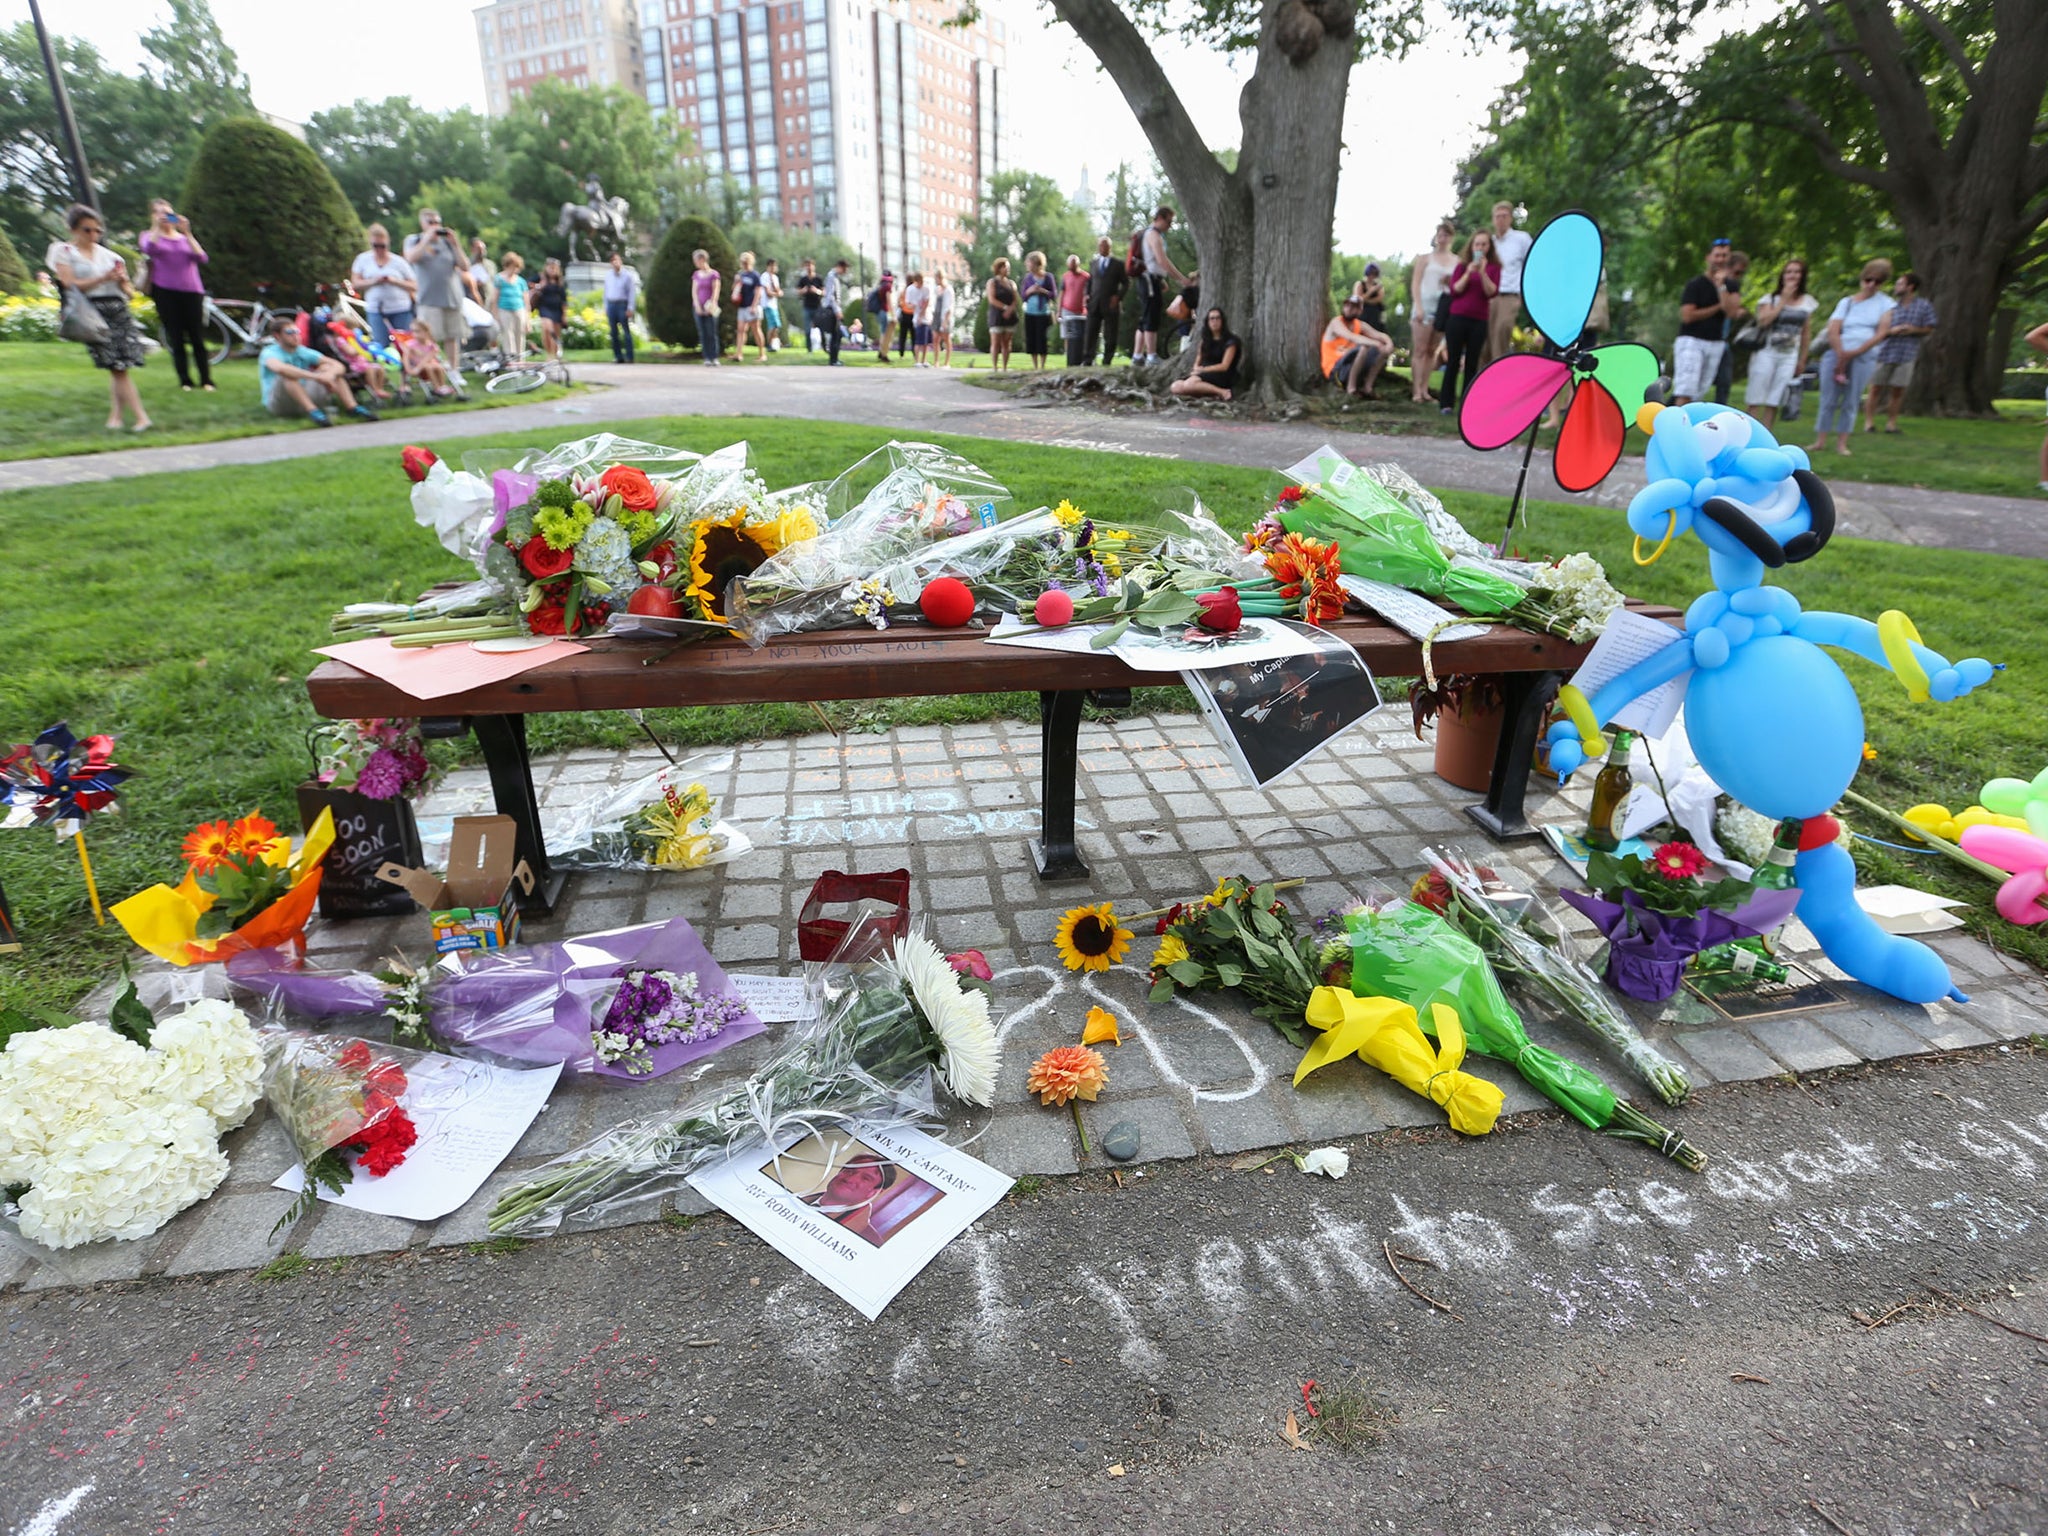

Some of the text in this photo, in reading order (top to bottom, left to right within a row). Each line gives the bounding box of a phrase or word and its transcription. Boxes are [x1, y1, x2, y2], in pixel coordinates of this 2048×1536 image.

[769, 646, 799, 660] NOT
[818, 643, 873, 660] YOUR
[885, 639, 946, 653] FAULT
[1249, 654, 1294, 685] My Capta
[335, 814, 367, 840] OO
[330, 823, 386, 869] SOON
[734, 978, 747, 987] YOU
[893, 1144, 918, 1160] MY
[764, 1196, 802, 1225] ROBIN
[799, 1220, 858, 1262] WILLIAMS
[1388, 1190, 1513, 1278] to
